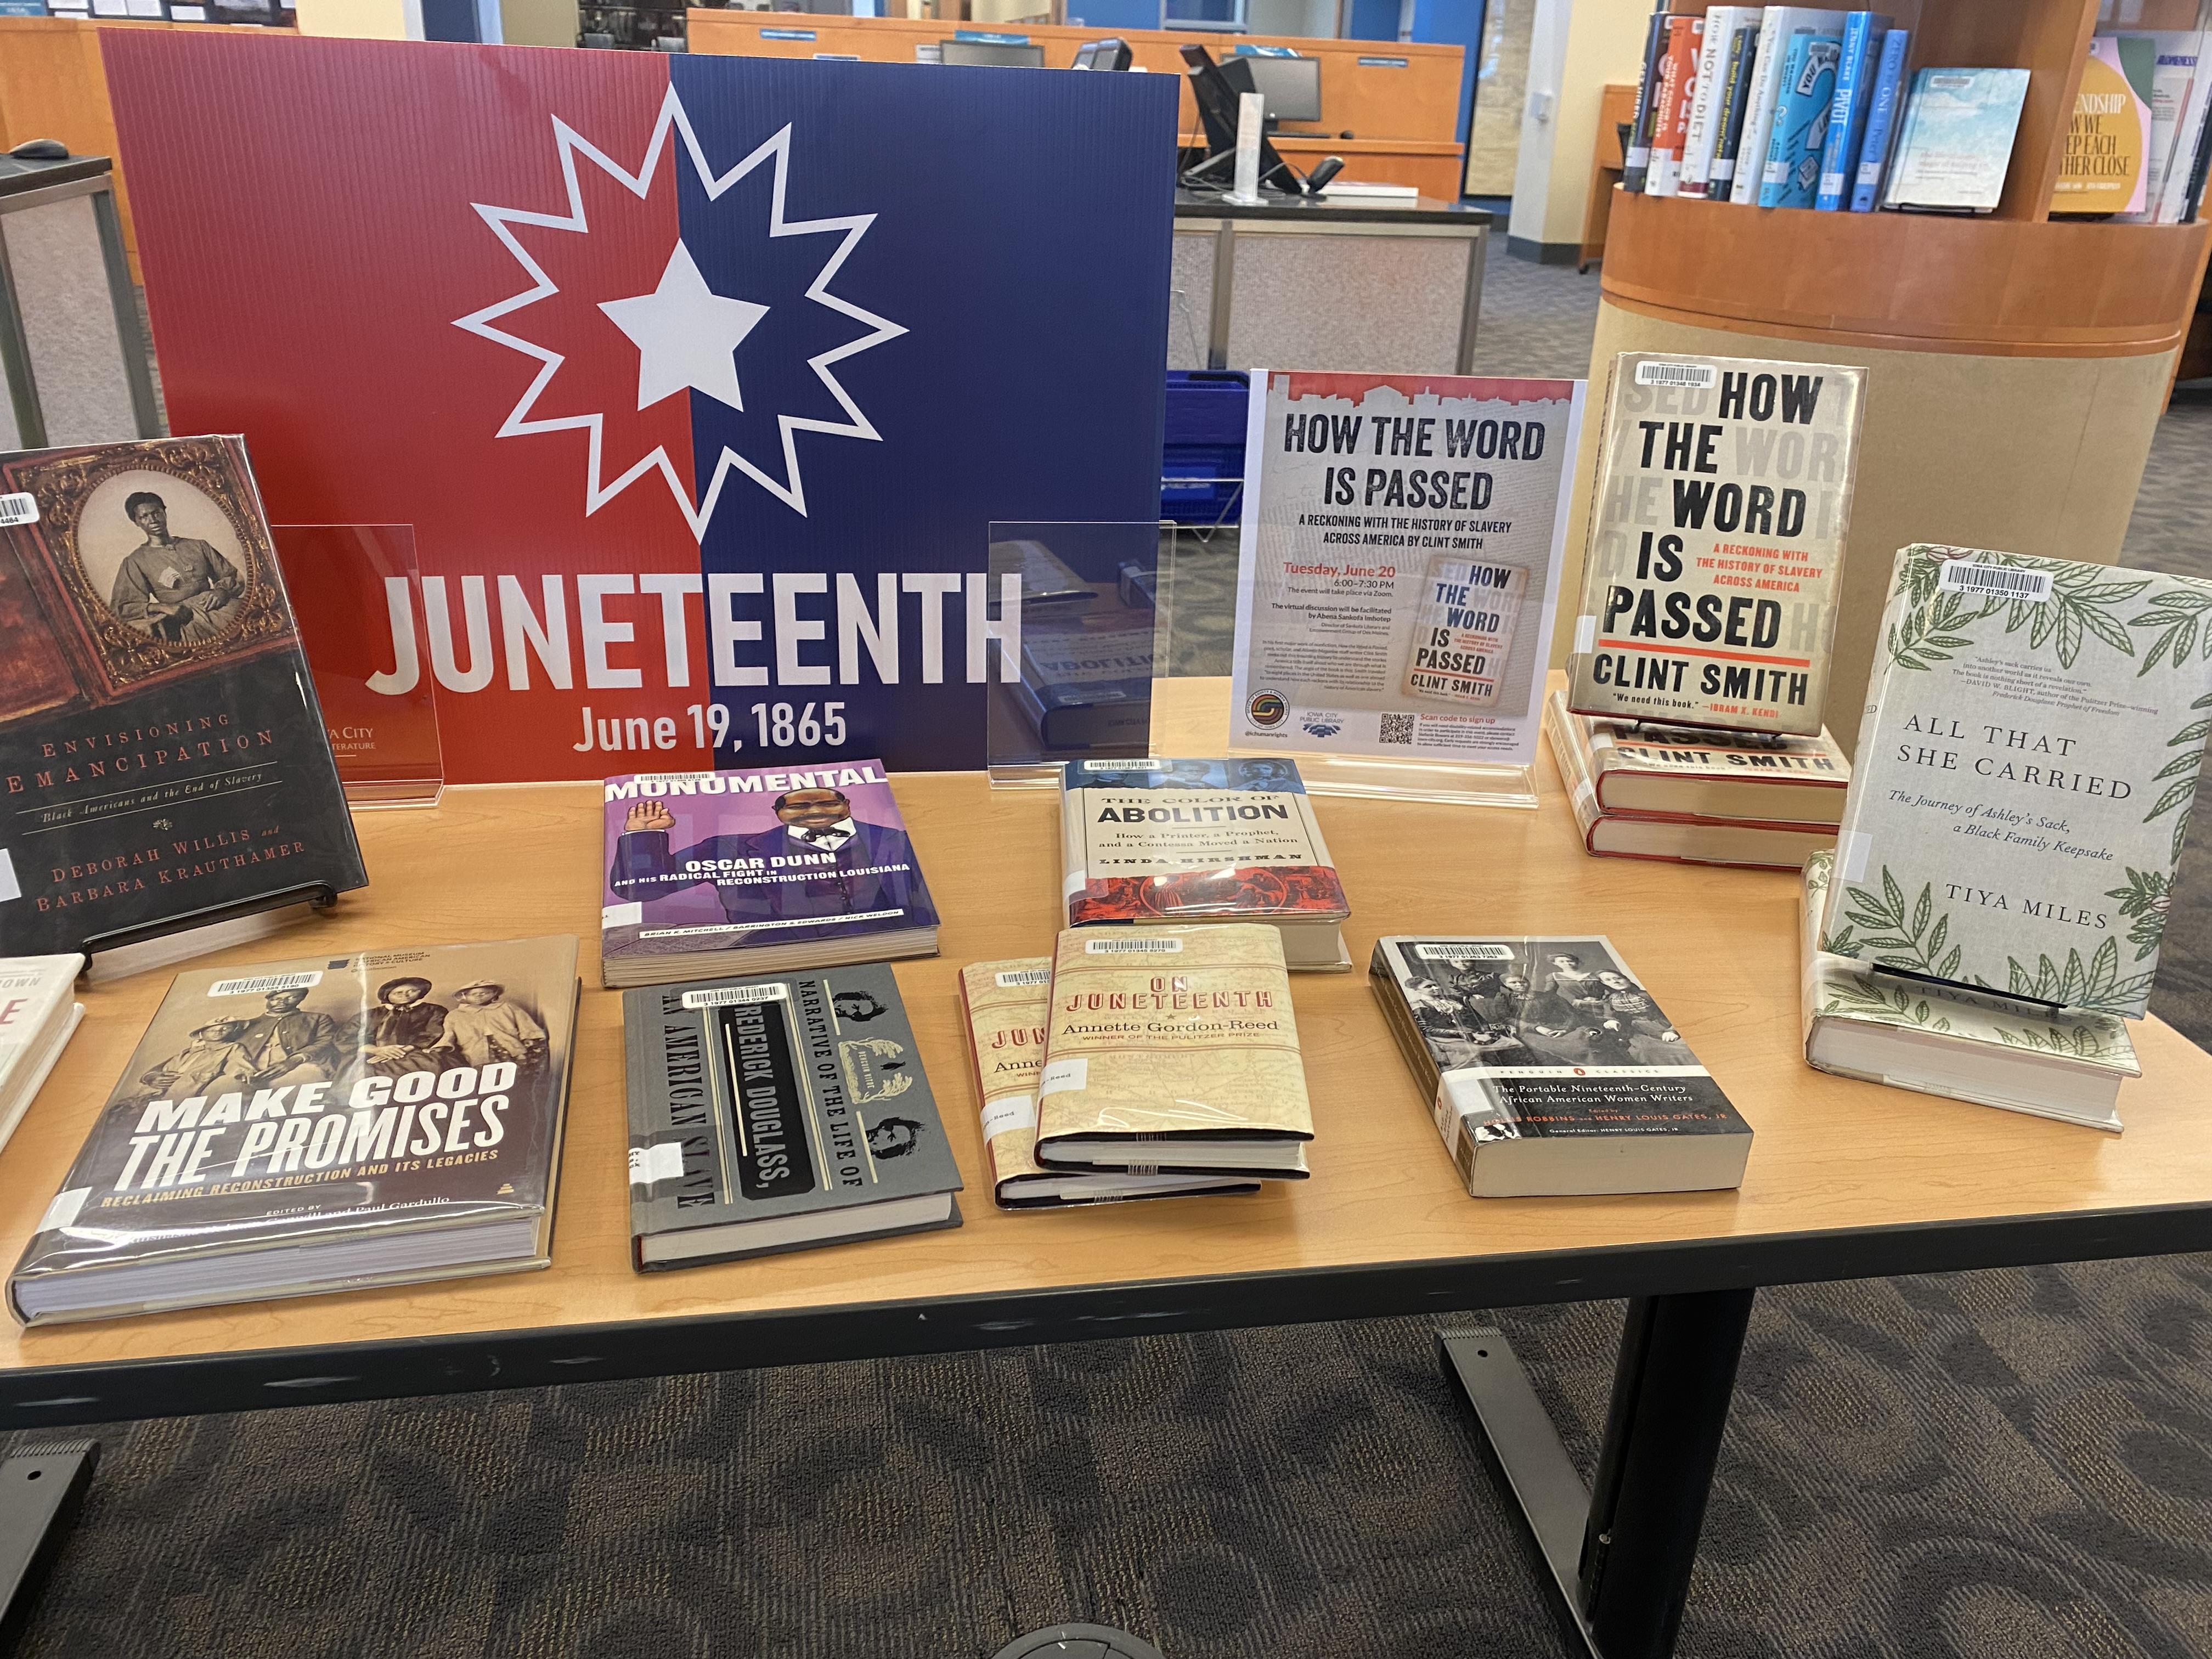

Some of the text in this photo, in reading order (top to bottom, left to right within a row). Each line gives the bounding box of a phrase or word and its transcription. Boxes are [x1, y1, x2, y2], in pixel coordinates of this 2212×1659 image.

[1692, 48, 1716, 140] NOT DIET
[1831, 88, 1853, 125] PIVOT
[1877, 87, 1892, 115] ONE
[2084, 135, 2116, 155] EACH
[2093, 156, 2130, 176] CLOSE
[1719, 371, 1823, 424] HOW
[1284, 414, 1545, 461] HOW THE WORD
[1639, 421, 1723, 473] THE
[1324, 467, 1493, 510] IS PASSED
[1299, 516, 1511, 533] A RECKONING WITH THE HISTORY OF SLAVERY
[1673, 479, 1807, 537] WORD
[1323, 533, 1483, 549] ACROSS AMERICA BY CLINT SMITH
[1636, 531, 1684, 582] IS
[1713, 544, 1808, 561] A RECKONING WITH
[1283, 562, 1396, 578] Tuesday, June 20
[1469, 565, 1511, 589] HOW
[1696, 557, 1822, 578] THE HISTORY OF SLAVERY
[1713, 574, 1799, 592] ACROSS AMERICA
[1436, 583, 1470, 606] THE
[364, 573, 1022, 695] JUNETEENTH
[1447, 607, 1499, 632] WORD
[1602, 585, 1781, 649] PASSED
[1431, 628, 1450, 647] IS
[1416, 648, 1485, 675] PASSED
[1593, 654, 1808, 706] CLINT SMITH
[1411, 674, 1448, 690] CLINT
[1452, 680, 1492, 697] SMITH
[42, 714, 229, 757] ENVISIONING
[573, 700, 845, 753] June 19, 1865
[1903, 714, 2078, 758] ALL THAT
[6, 730, 272, 793] EMANCIPATION
[1897, 744, 2132, 800] SHE CARRIED
[42, 773, 262, 822] Black Americans and the End of Slavery
[605, 766, 888, 802] MONUMENTAL
[1097, 804, 1289, 823] ABOLITION
[1888, 789, 1911, 805] The
[1912, 793, 1962, 815] Journey
[1966, 800, 1981, 818] of
[2036, 814, 2070, 834] Sack,
[1226, 828, 1278, 837] Prophet,
[1966, 823, 2113, 862] Black Family Keepsake
[52, 825, 279, 882] DEBORAH WILLIS and
[685, 853, 836, 872] OSCAR DUNN
[1180, 854, 1302, 864] HIRSHMAN
[36, 841, 304, 912] BARBARA KRAUTHAMER
[614, 879, 636, 887] AND
[659, 871, 720, 882] RADICAL
[723, 868, 763, 879] FIGHT
[717, 863, 910, 886] RECONSTRUCTION LOUISIANA
[1946, 883, 2108, 929] TIYA MILES
[1066, 991, 1273, 1012] JUNETEENTH
[1151, 976, 1188, 992] ON
[1062, 1020, 1279, 1035] Annette Gordon-Reed
[664, 1024, 707, 1126] AMERICAN
[799, 980, 863, 1188] NARRATIVE OF THE LIFE OF
[1493, 1084, 1516, 1093] The
[1519, 1084, 1567, 1093] Portable
[135, 1062, 517, 1133] MAKE GOOD
[734, 1005, 790, 1189] REDERICK DOUGLASS,
[1499, 1093, 1692, 1105] African American Women Writers
[114, 1094, 510, 1191] THE PROMISES
[101, 1150, 498, 1207] RECLAIMING RECONSTRUCTION AND ITS LEGACIES
